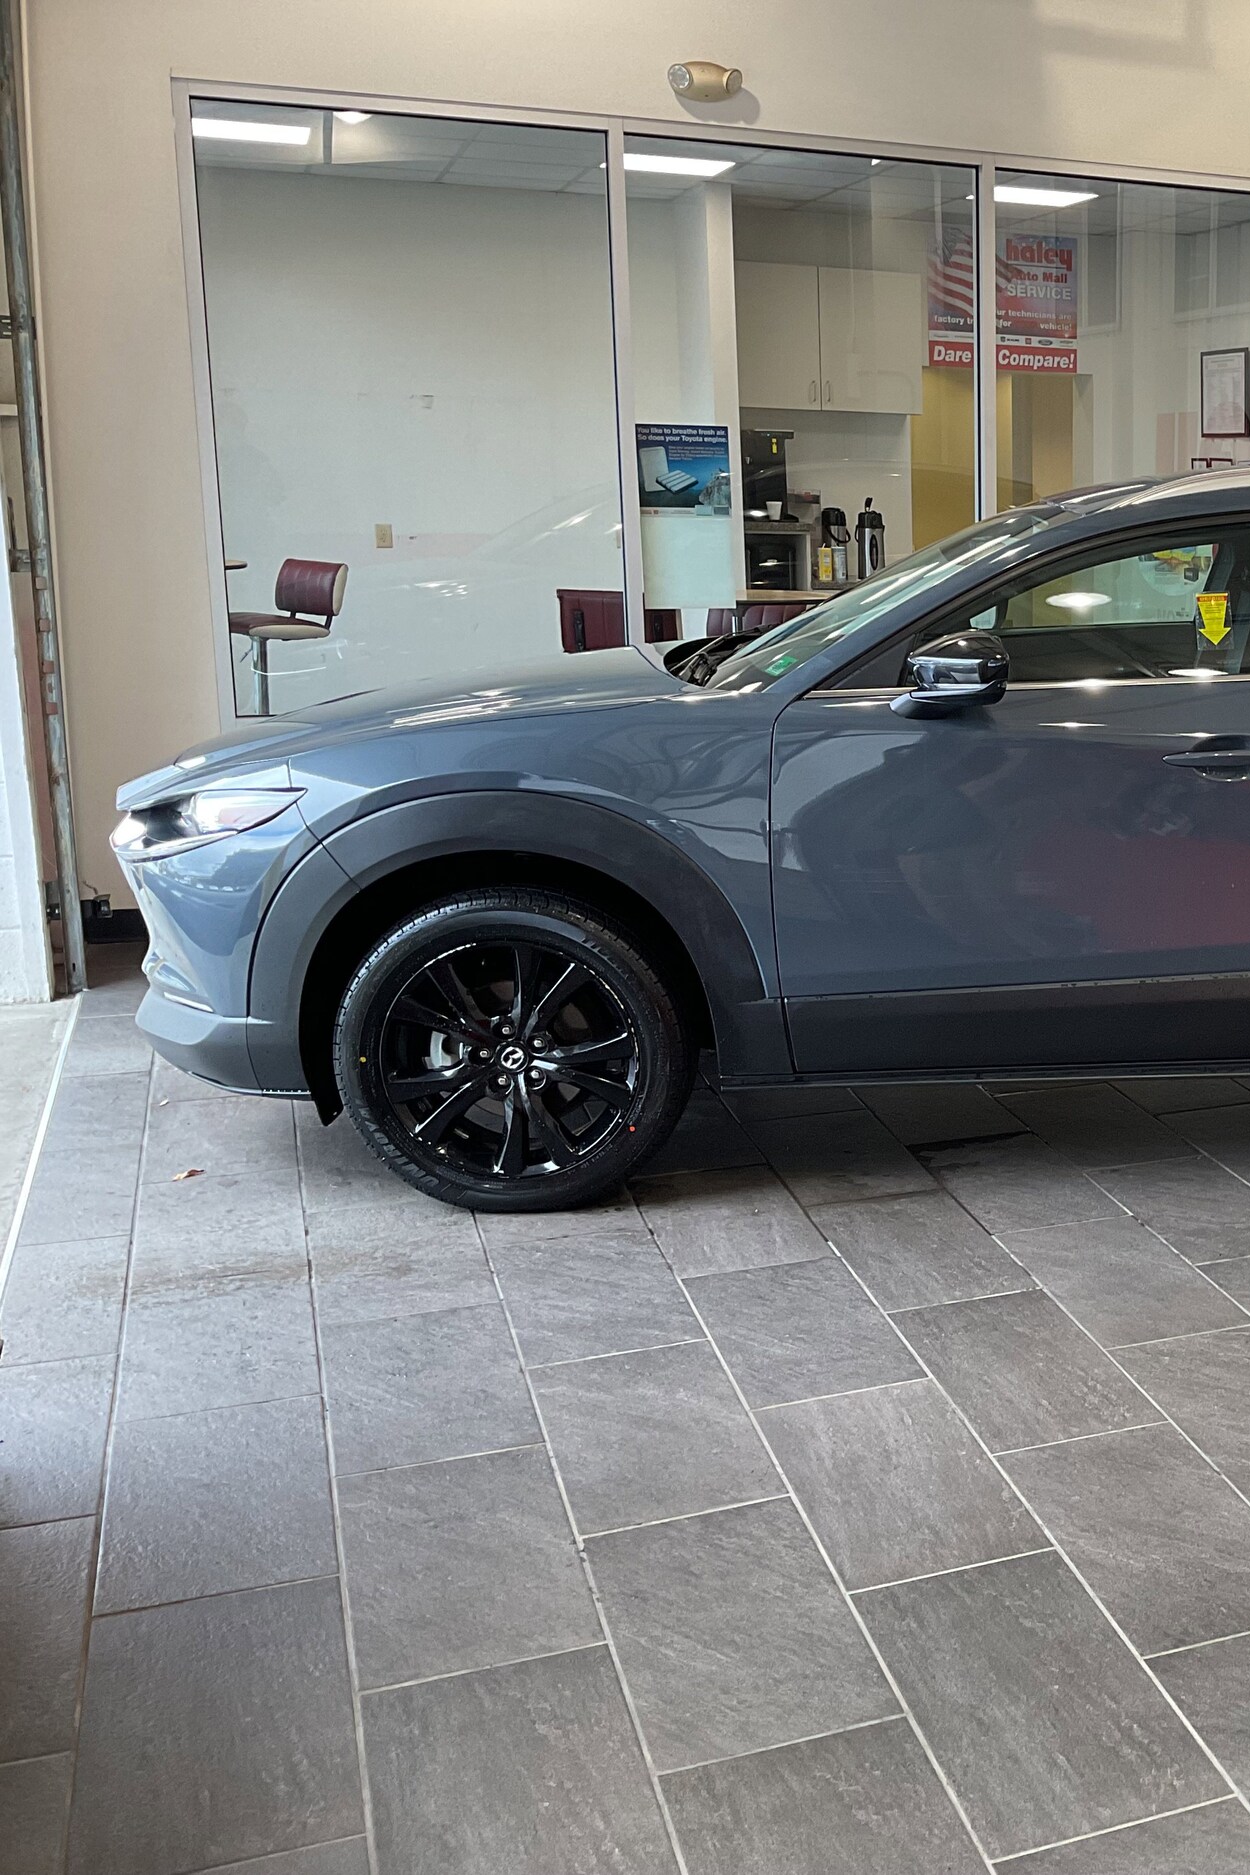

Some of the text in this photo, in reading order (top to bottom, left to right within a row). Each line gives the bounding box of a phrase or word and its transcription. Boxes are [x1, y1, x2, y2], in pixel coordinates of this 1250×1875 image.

[1006, 239, 1073, 272] haley
[1043, 271, 1068, 284] Mall
[1007, 283, 1072, 300] SERVICE
[934, 314, 965, 326] factory
[1008, 309, 1056, 319] technicians
[1000, 318, 1073, 331] for vehicle!
[933, 345, 1074, 370] Dare Compare!
[680, 434, 703, 443] Toyota
